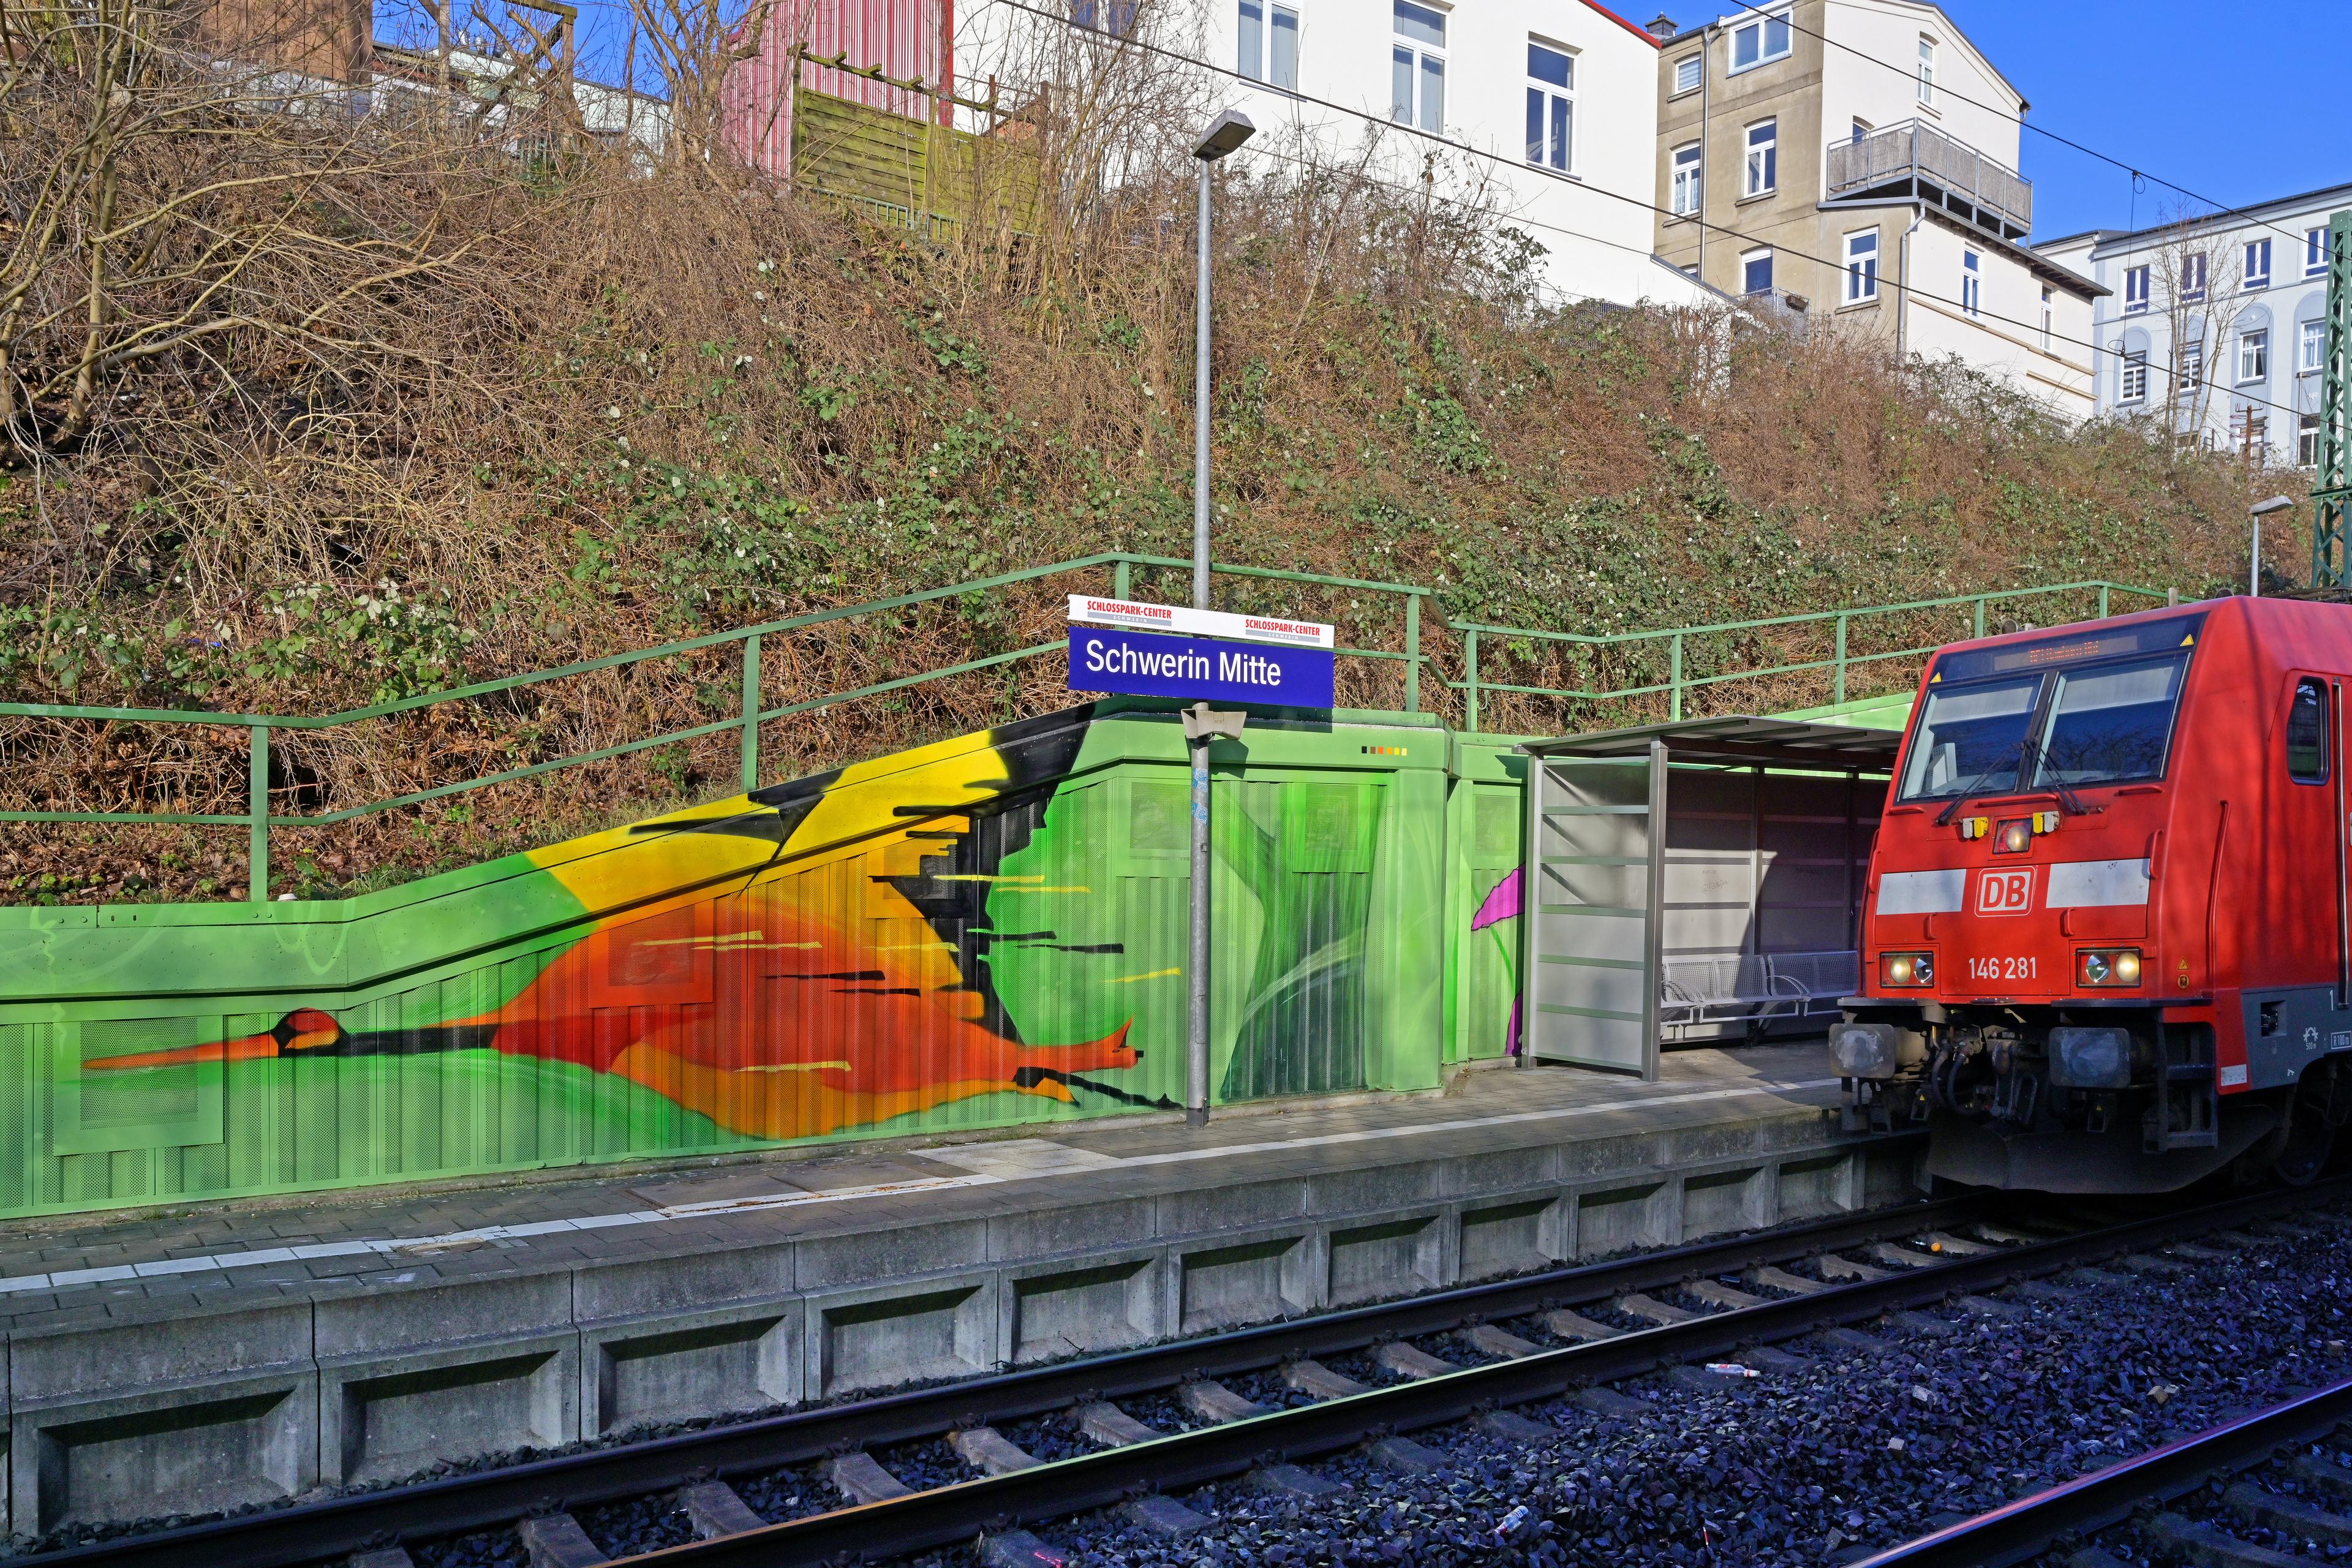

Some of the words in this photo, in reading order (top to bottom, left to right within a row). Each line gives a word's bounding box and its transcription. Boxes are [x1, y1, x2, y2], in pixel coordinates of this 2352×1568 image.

[1087, 600, 1172, 619] SCHLOSSPARK-CENTER
[1113, 615, 1148, 624] SCHWERIN
[1245, 619, 1320, 636] SCHLOSSPARK-CENTER
[1085, 639, 1210, 680] Schwerin
[1219, 651, 1281, 686] Mitte
[1983, 875, 2026, 908] DB
[1969, 957, 1999, 979] 146
[2004, 957, 2036, 979] 281
[2329, 990, 2334, 1011] 1
[2333, 1035, 2337, 1047] R
[2345, 1036, 2350, 1045] m
